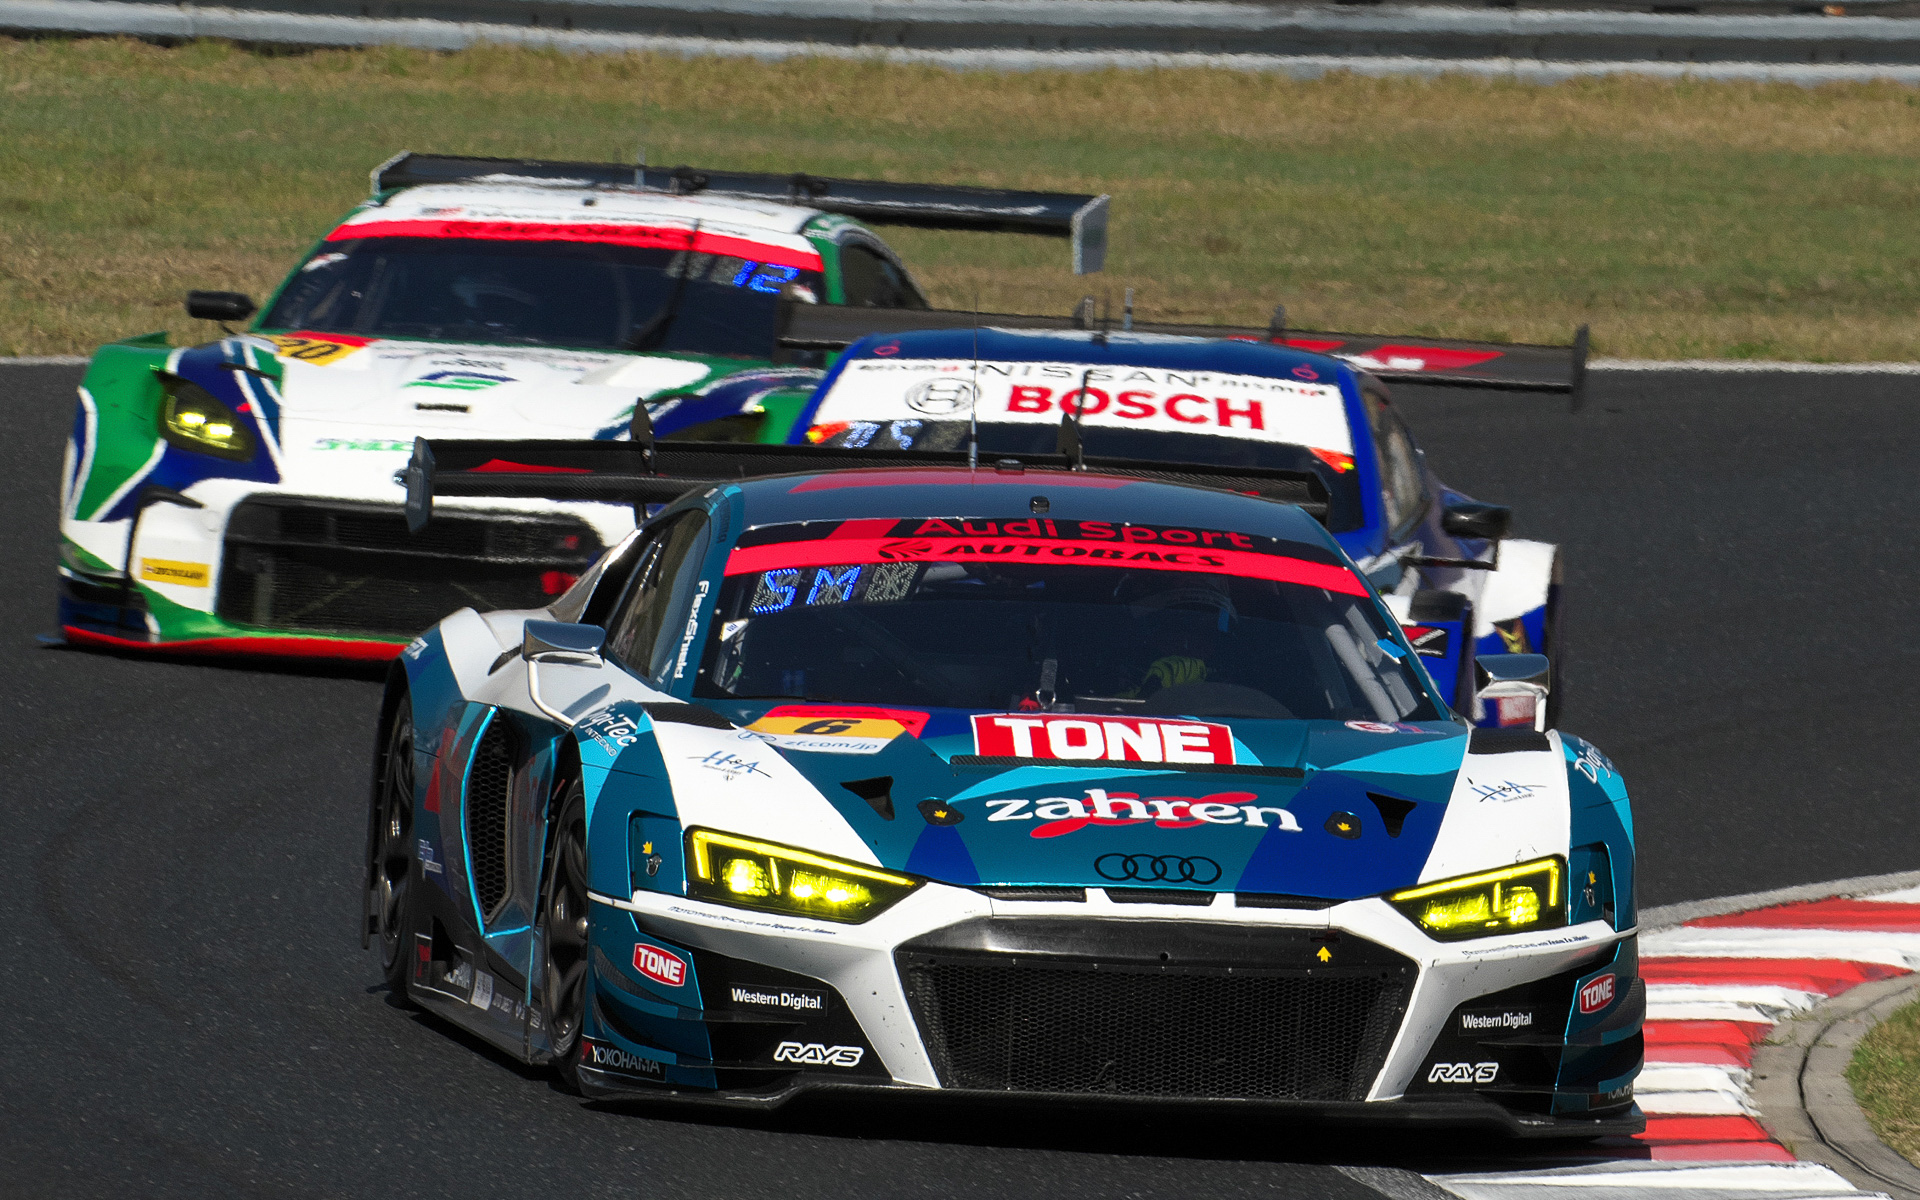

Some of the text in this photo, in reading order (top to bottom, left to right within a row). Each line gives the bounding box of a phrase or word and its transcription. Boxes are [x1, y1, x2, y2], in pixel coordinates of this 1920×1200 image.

[733, 260, 800, 294] 12
[980, 364, 1198, 388] NISSAN
[1006, 383, 1266, 431] BOSCH
[911, 517, 1254, 548] Audi Sport
[940, 544, 1226, 567] AUTOBACS
[673, 580, 710, 679] FlexShield
[793, 719, 863, 735] 6
[994, 717, 1215, 764] TONE
[985, 788, 1304, 833] zahren
[638, 947, 682, 983] TONE
[731, 987, 779, 1006] Western
[1583, 978, 1613, 1010] TONE
[1462, 1012, 1532, 1030] Western Digital
[592, 1045, 661, 1075] YOKOHAMA
[773, 1041, 864, 1067] RAYS
[1428, 1061, 1500, 1083] RAYS
